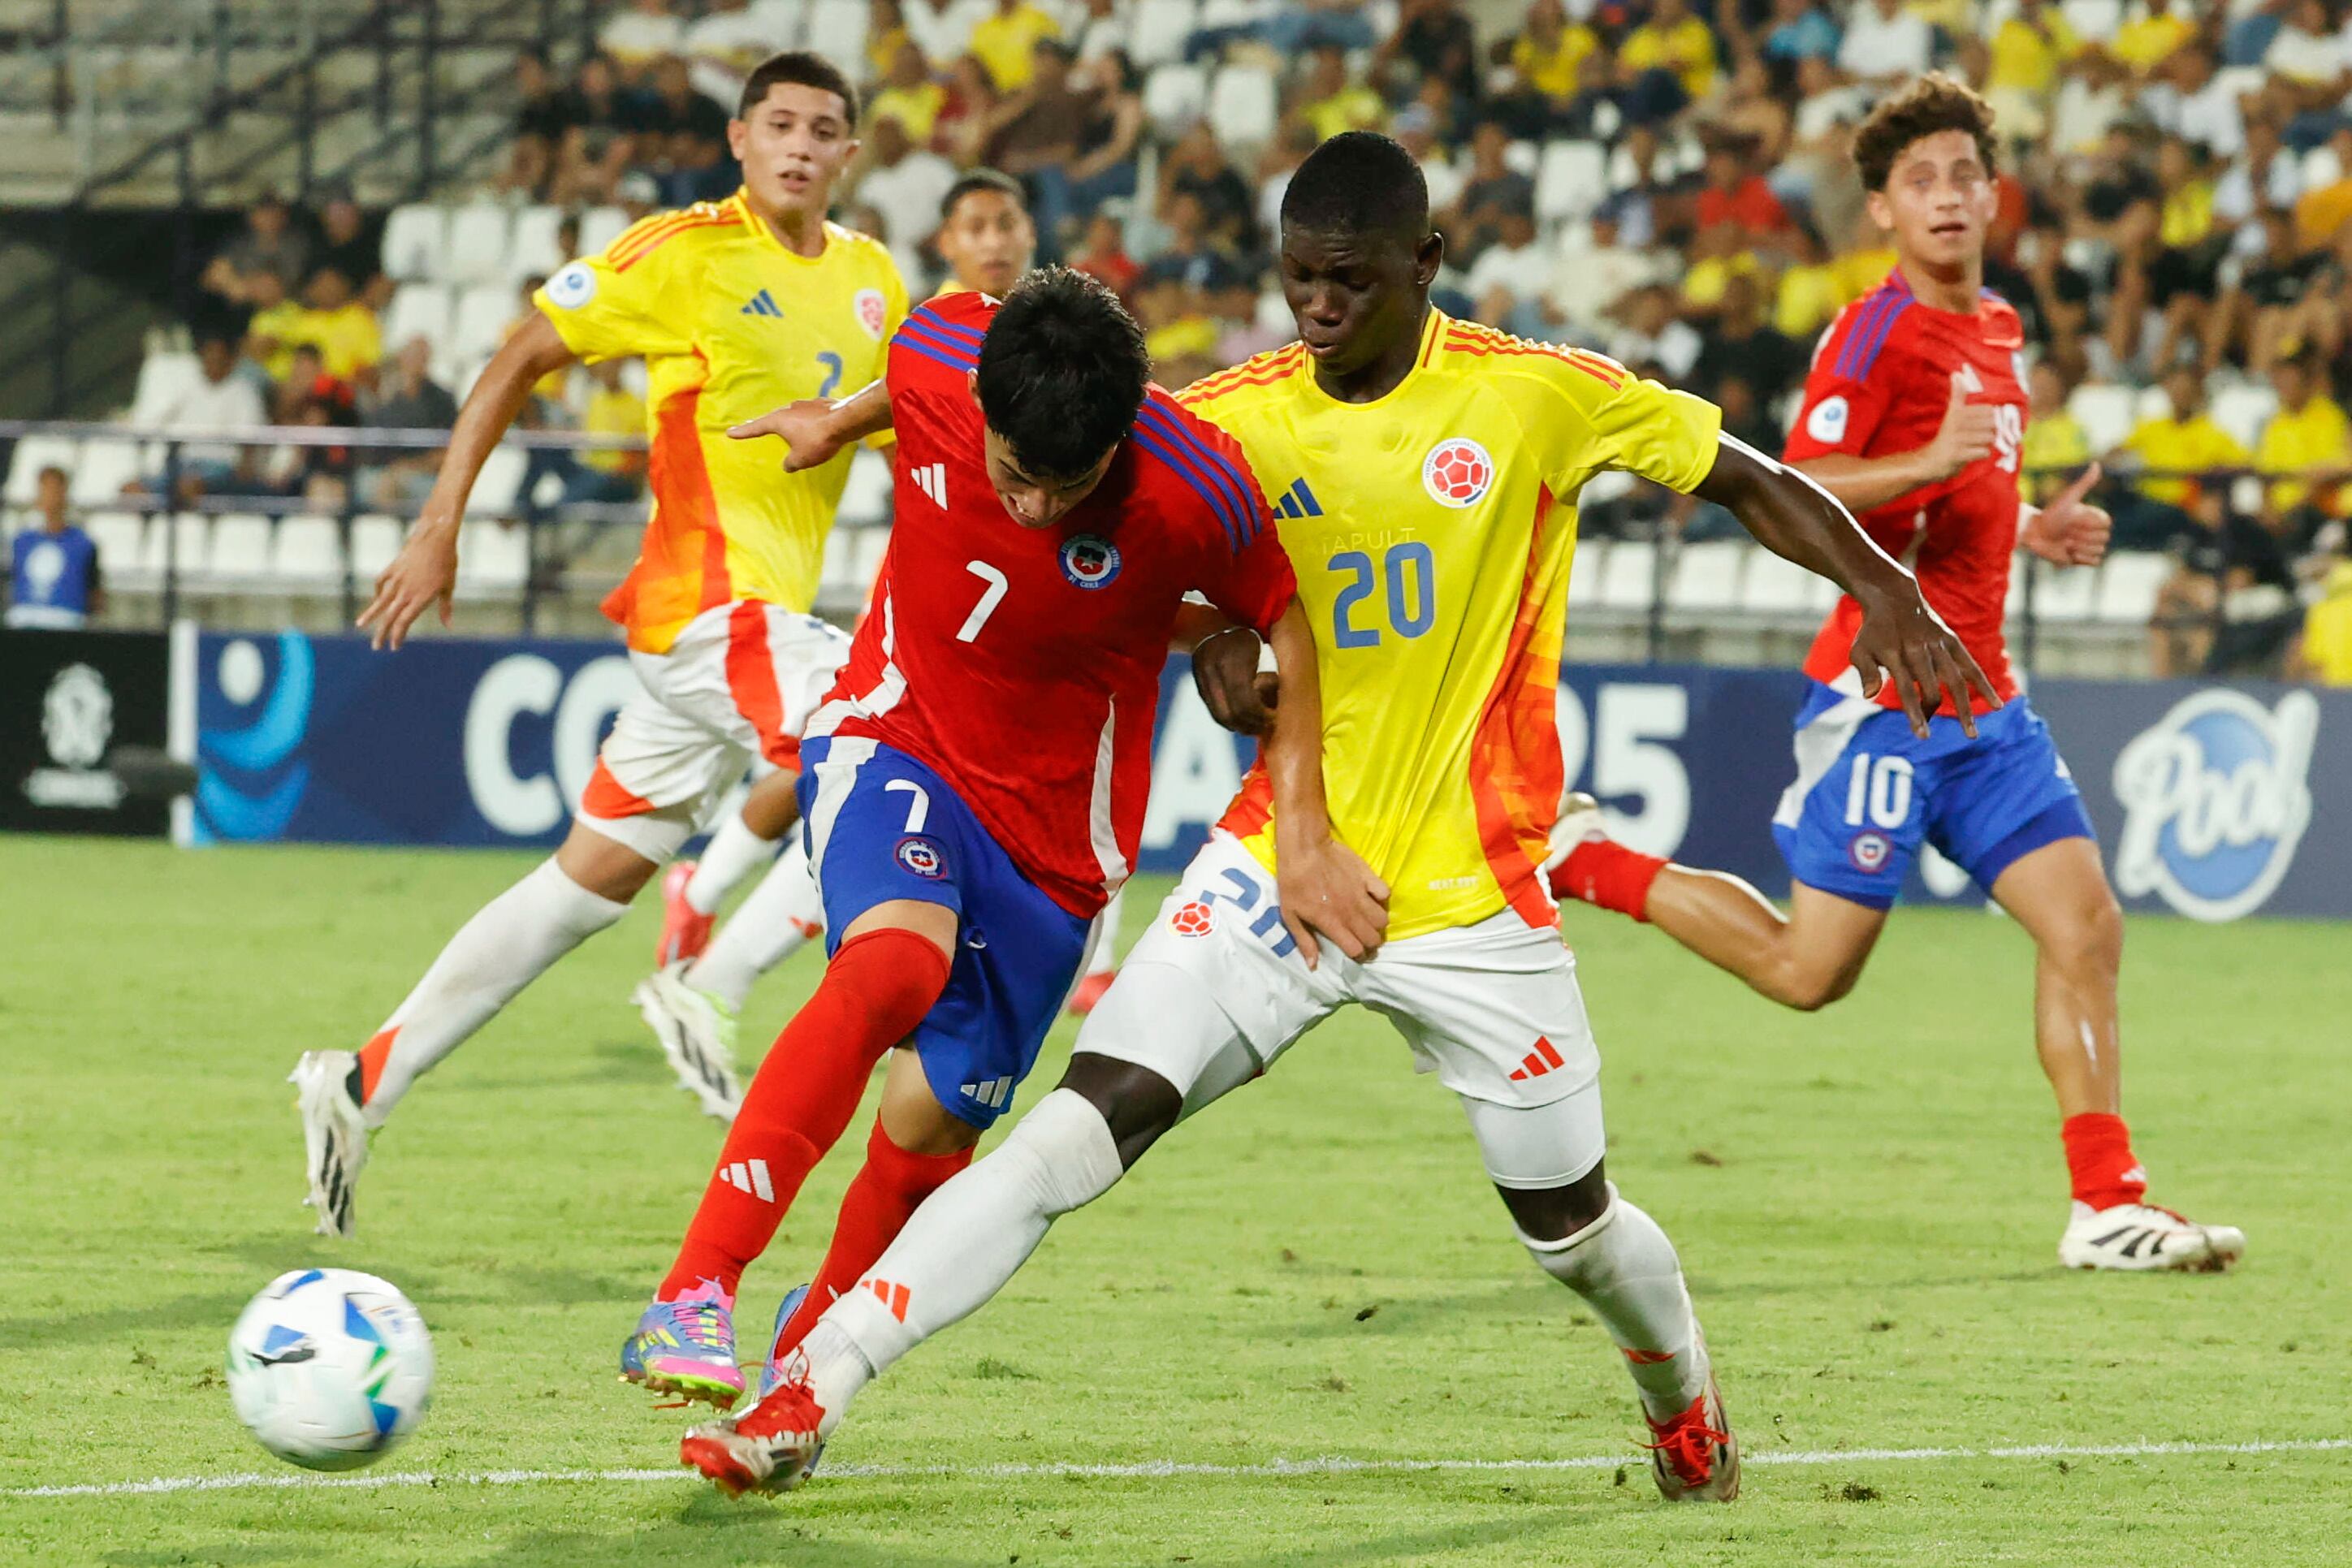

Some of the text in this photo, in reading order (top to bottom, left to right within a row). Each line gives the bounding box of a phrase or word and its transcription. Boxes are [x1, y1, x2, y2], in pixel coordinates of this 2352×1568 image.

[955, 559, 1009, 643] 7
[1327, 541, 1435, 649] 20
[884, 778, 930, 833] 7
[1844, 752, 1915, 830] 10
